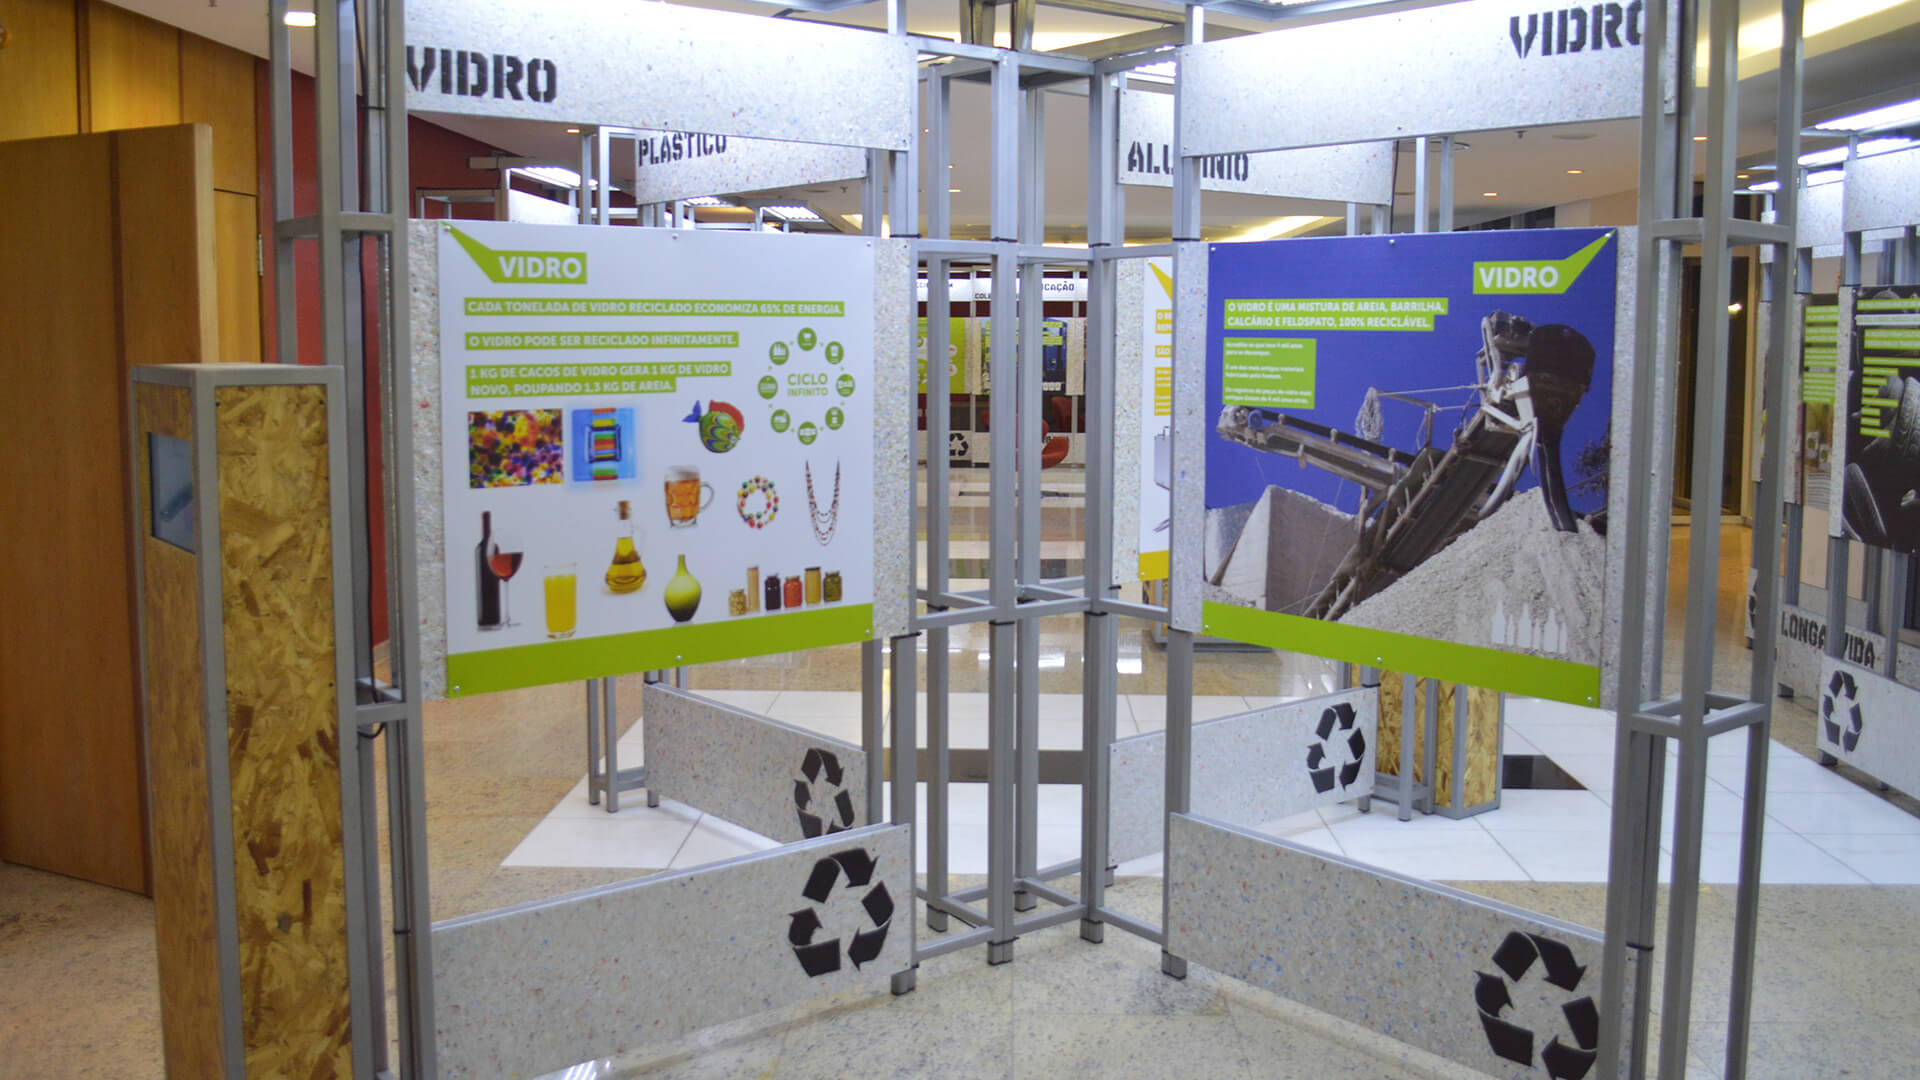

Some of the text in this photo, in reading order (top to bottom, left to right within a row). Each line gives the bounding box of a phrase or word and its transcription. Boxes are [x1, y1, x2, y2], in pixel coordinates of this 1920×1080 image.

[406, 45, 557, 103] VIDRO
[498, 255, 583, 279] VIDRO
[1479, 265, 1559, 289] VIDRO
[467, 301, 502, 312] CADA
[504, 301, 570, 313] TONELADA
[572, 302, 587, 313] DE
[589, 302, 627, 313] VIDRO
[628, 302, 692, 313] RECICLADO
[694, 302, 759, 314] ECONOMIZA
[783, 303, 796, 314] DE
[1227, 302, 1236, 312] O
[1237, 302, 1266, 312] VIDRO
[1267, 300, 1273, 312] É
[1274, 302, 1296, 312] UMA
[1297, 302, 1340, 312] MISTURA
[1342, 302, 1355, 312] DE
[1227, 315, 1273, 327] CALCÁRIO
[1275, 317, 1280, 327] E
[1339, 317, 1365, 327] 100%
[469, 336, 480, 347] O
[482, 336, 522, 347] VIDRO
[524, 335, 557, 346] PODE
[559, 335, 581, 346] SER
[584, 335, 649, 346] RECICLADO
[470, 363, 729, 379] 1 KG DE CACOS DE VIDRO GERA 1 KG DE VIDRO
[787, 372, 829, 386] CICLO
[513, 382, 582, 394] POUPANDO
[603, 381, 619, 392] KG
[621, 381, 637, 391] DE
[787, 387, 829, 397] INFINITO
